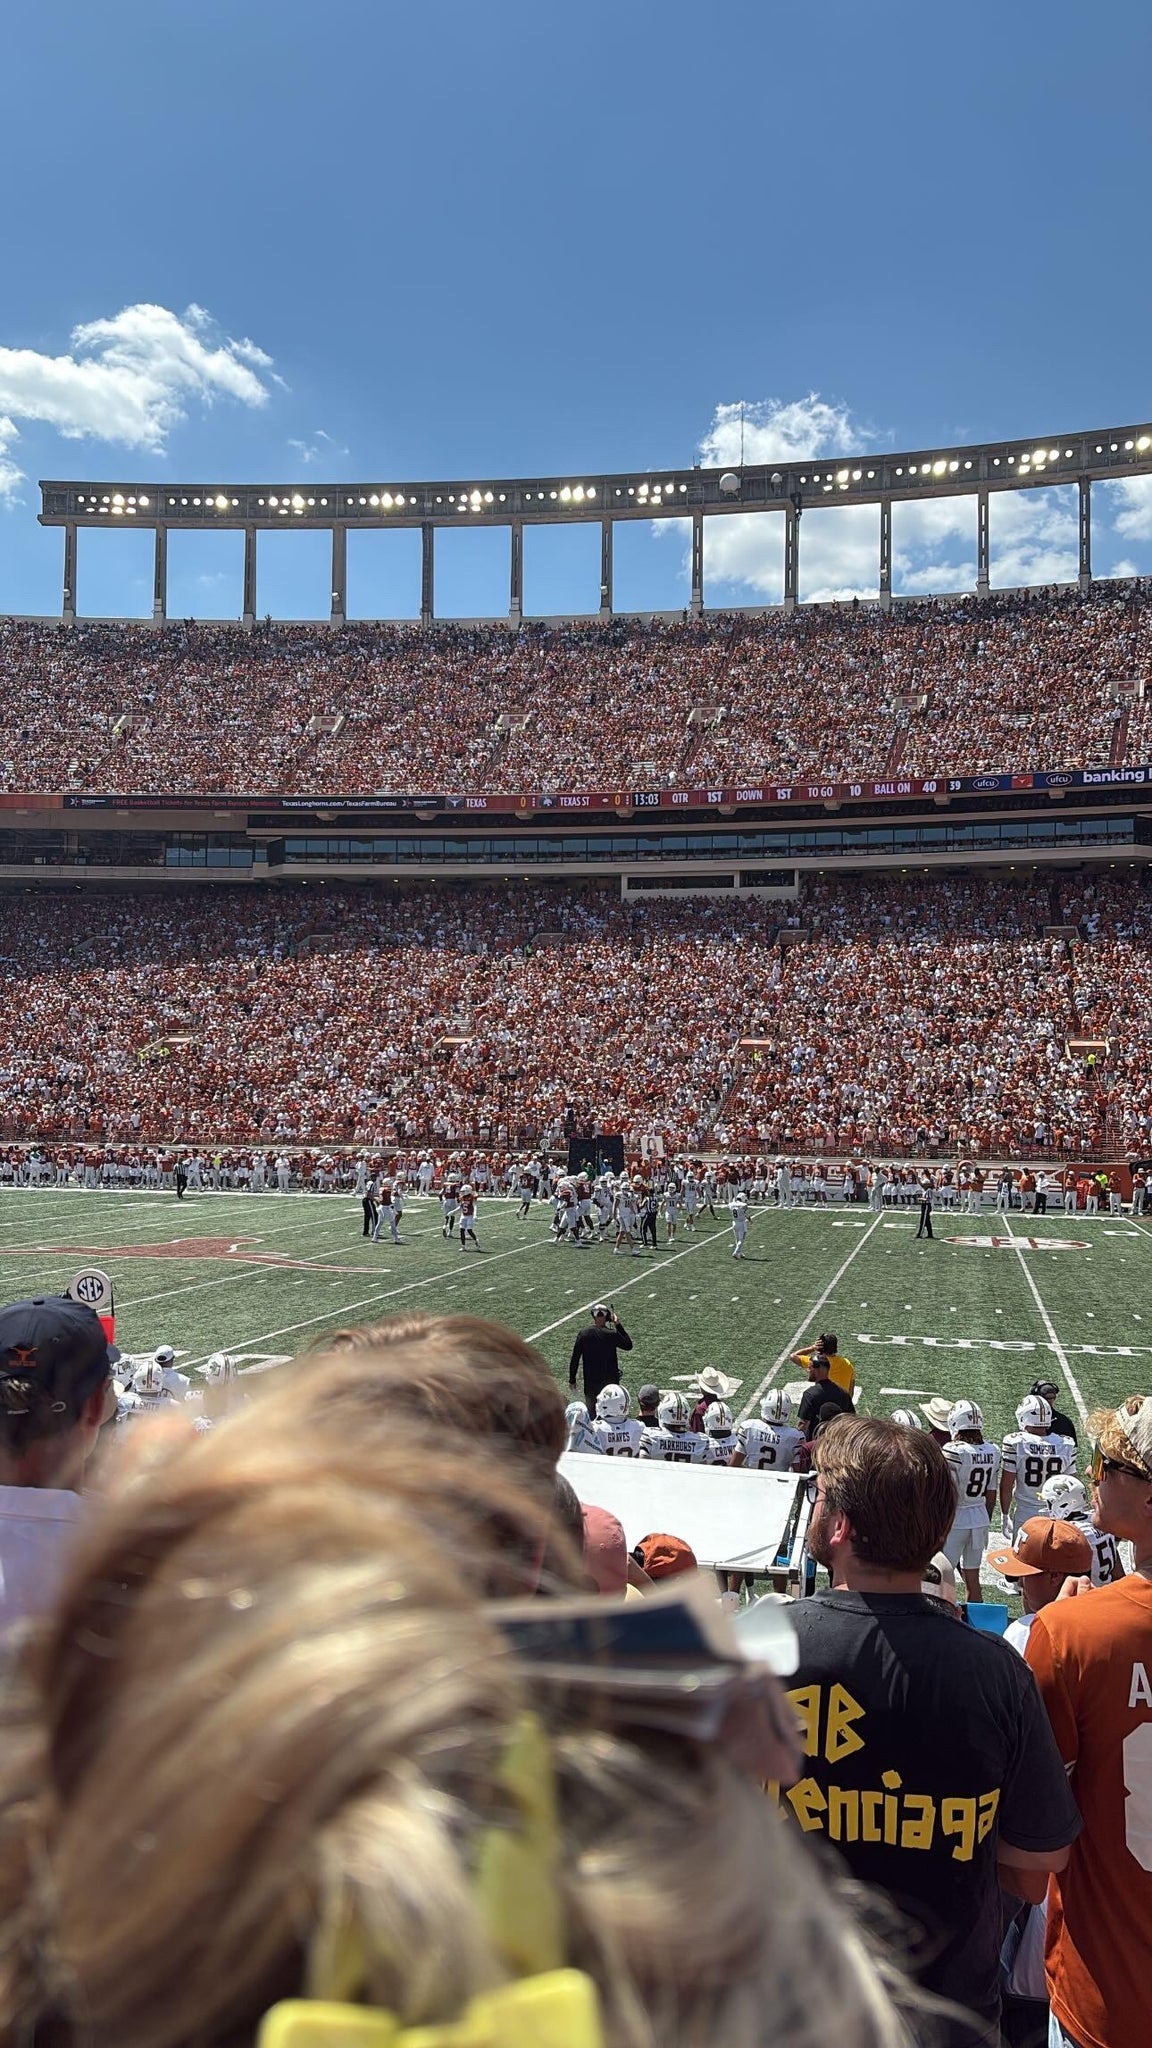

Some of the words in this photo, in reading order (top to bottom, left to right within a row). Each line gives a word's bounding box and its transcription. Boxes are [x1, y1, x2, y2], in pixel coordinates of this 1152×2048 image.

[977, 780, 995, 788] ufcu
[1050, 775, 1068, 784] ufcu
[1083, 769, 1144, 786] banking
[808, 787, 819, 798] TO
[820, 786, 833, 797] GO
[850, 785, 862, 796] 10
[874, 783, 896, 794] BALL
[897, 782, 911, 793] ON
[922, 781, 937, 793] 40
[949, 780, 961, 791] 39
[560, 797, 580, 806] TEXAS
[580, 796, 590, 806] ST
[615, 794, 621, 805] 0
[635, 793, 659, 804] 13:03
[672, 792, 689, 803] QTR
[707, 791, 723, 803] 1ST
[736, 790, 763, 801] DOWN
[776, 788, 792, 800] 1ST
[282, 800, 397, 808] TexasLonghorns.com/TexasFarmBureau
[466, 798, 487, 808] TEXAS
[78, 1276, 103, 1301] SEC
[607, 1431, 631, 1443] GRAVES
[760, 1431, 781, 1445] EVANS
[659, 1439, 697, 1453] PARKHURST
[1029, 1443, 1056, 1456] SIMPSON
[1024, 1456, 1063, 1487] 88
[966, 1467, 993, 1498] 81
